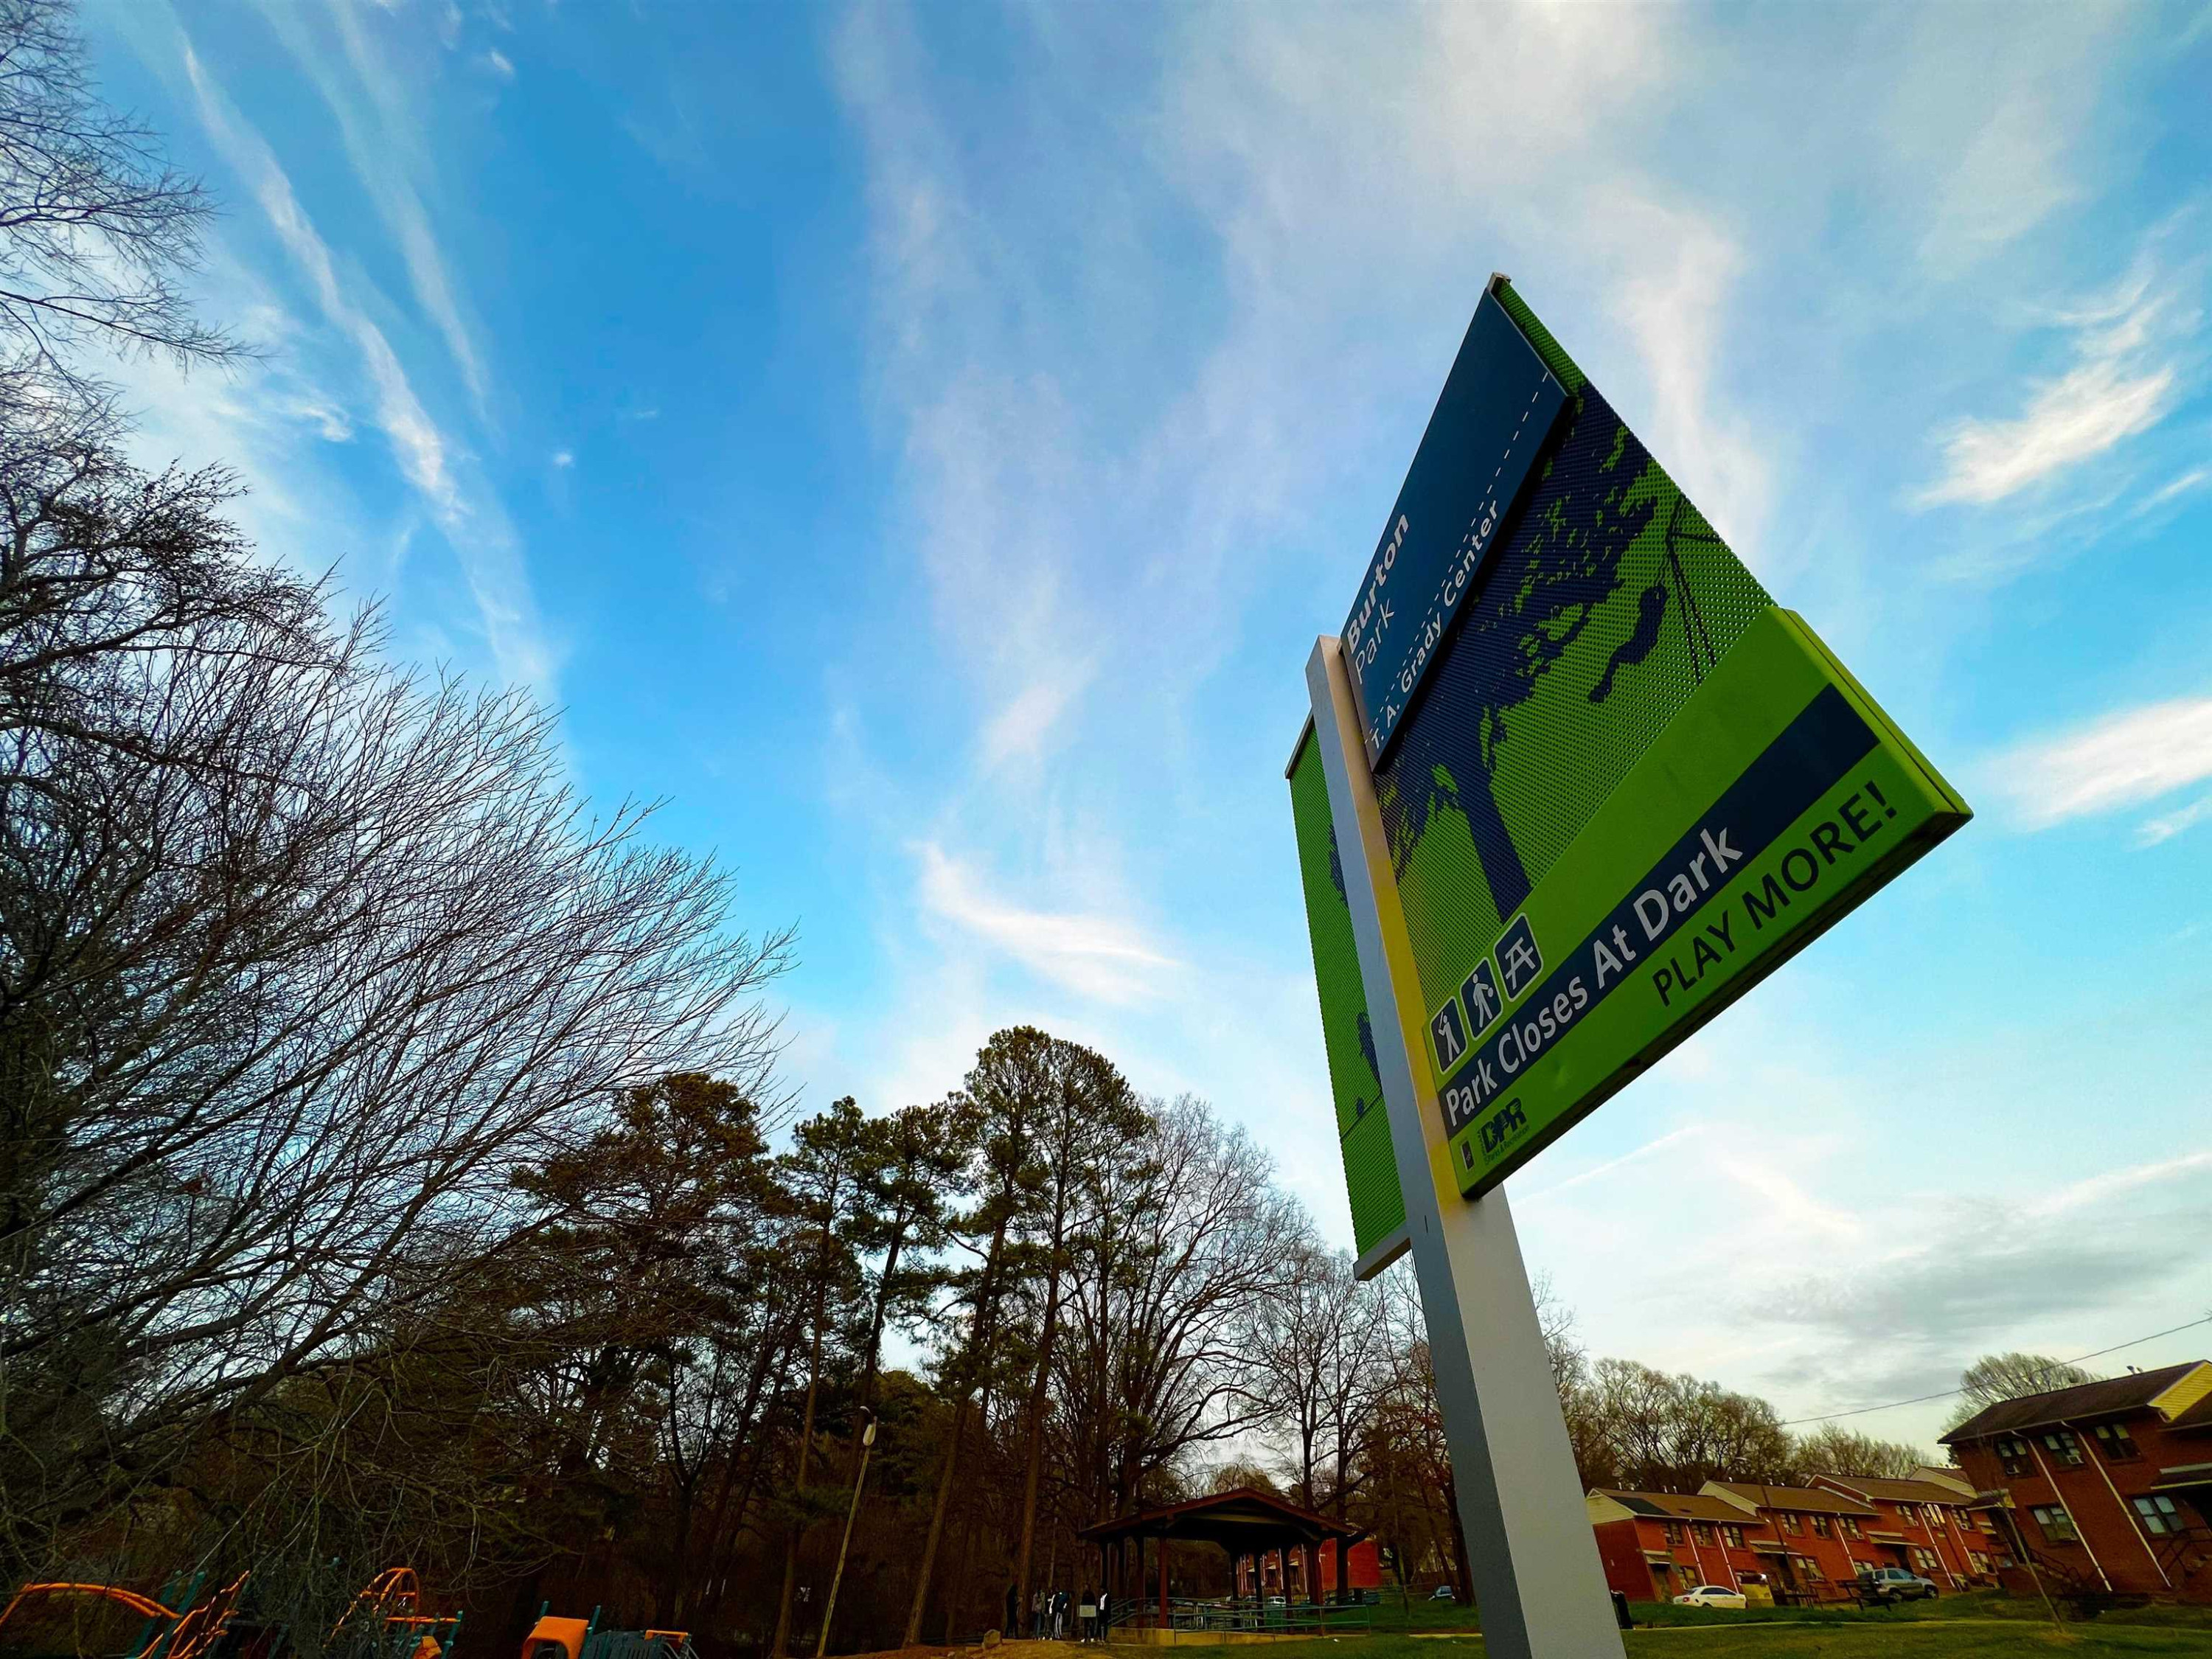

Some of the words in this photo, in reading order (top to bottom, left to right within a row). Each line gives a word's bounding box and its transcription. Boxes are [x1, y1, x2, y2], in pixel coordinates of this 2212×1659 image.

[1346, 515, 1409, 654] Burton
[1354, 599, 1395, 685] Park
[1371, 728, 1385, 749] T.
[1385, 703, 1400, 728] A.
[1401, 613, 1441, 693] Grady
[1443, 500, 1497, 607] Center
[1446, 1060, 1498, 1127] Park
[1498, 975, 1587, 1073] Closes
[1593, 924, 1637, 990] At
[1632, 827, 1743, 942] Dark
[1652, 910, 1736, 1007] PLAY
[1742, 780, 1897, 931] MORE!
[1481, 1097, 1527, 1153] DPR
